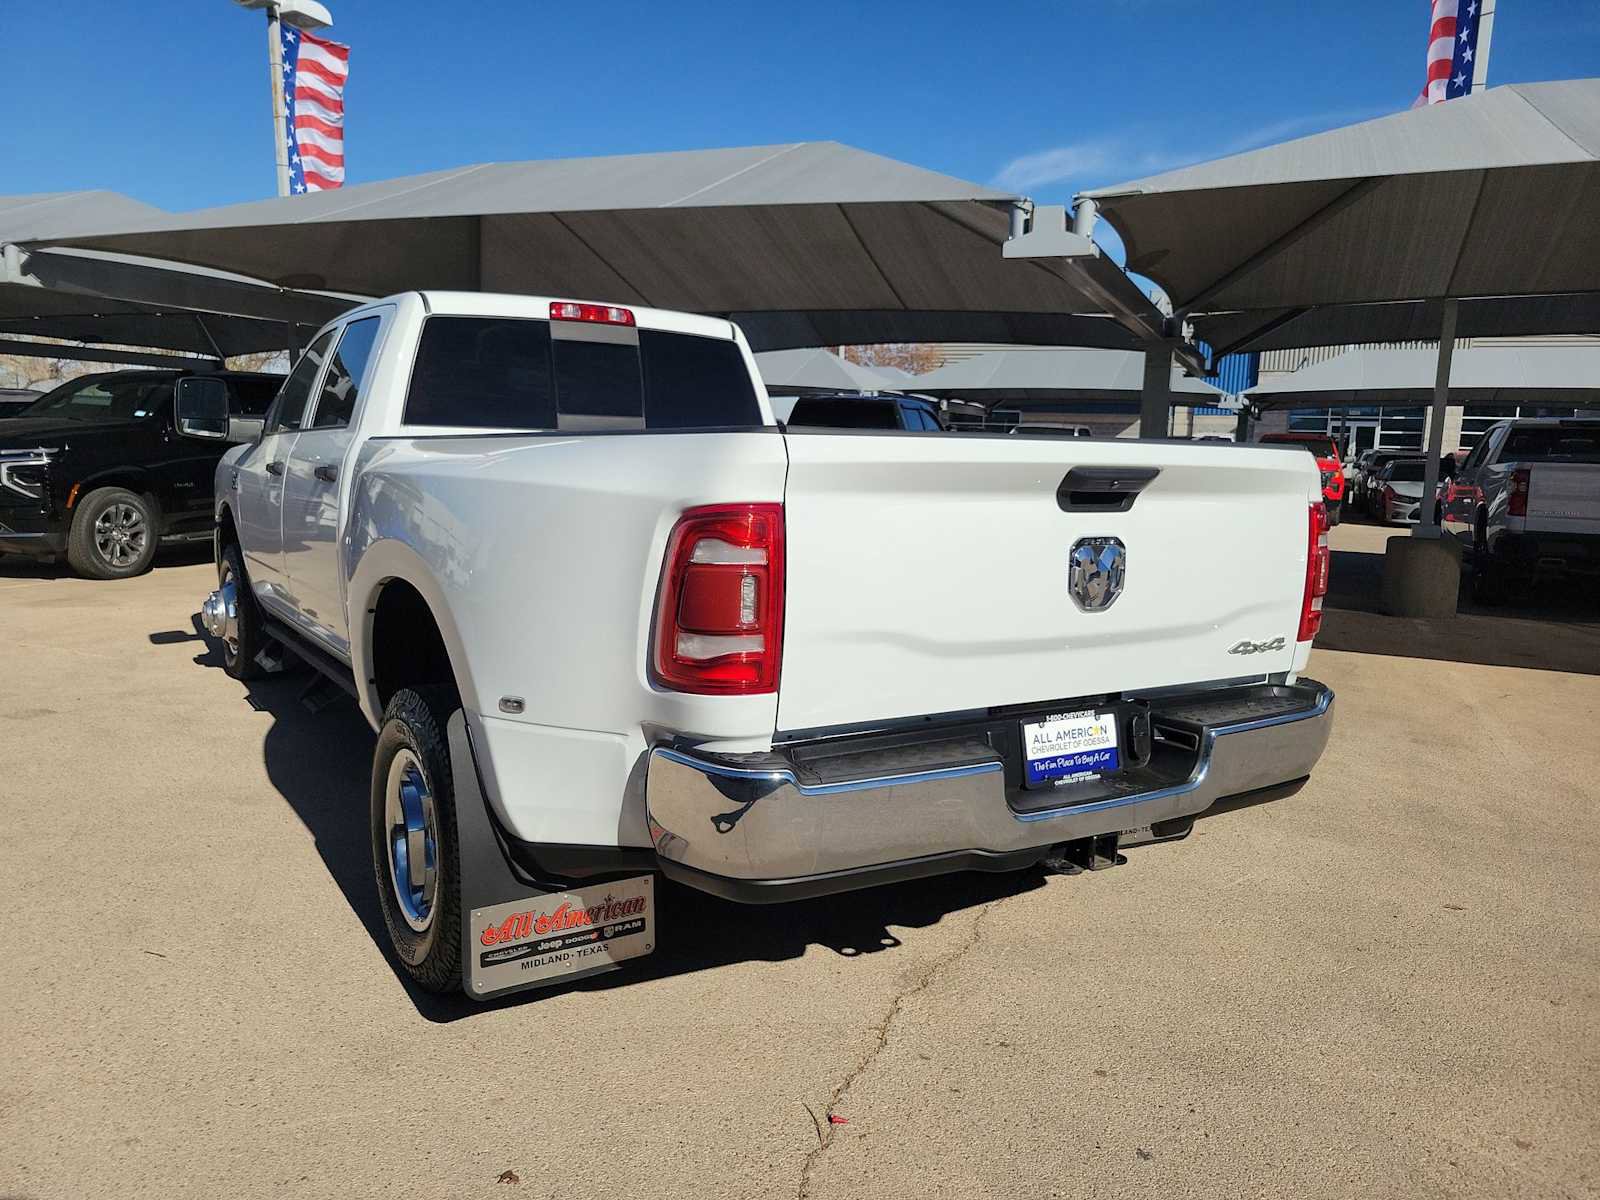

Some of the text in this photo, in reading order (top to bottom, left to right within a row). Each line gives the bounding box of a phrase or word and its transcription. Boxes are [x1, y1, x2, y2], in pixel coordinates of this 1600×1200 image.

[1227, 637, 1286, 655] 4x4
[1031, 736, 1110, 755] CHEVROLET OF ODESSA
[1033, 733, 1053, 745] ALL
[1033, 751, 1111, 772] The Fun Place To Buy A Car
[1120, 827, 1138, 836] LAND
[480, 893, 647, 946] All American
[537, 940, 563, 951] Jeep
[615, 920, 642, 932] RAM
[521, 943, 609, 970] MIDLAND TEXAS
